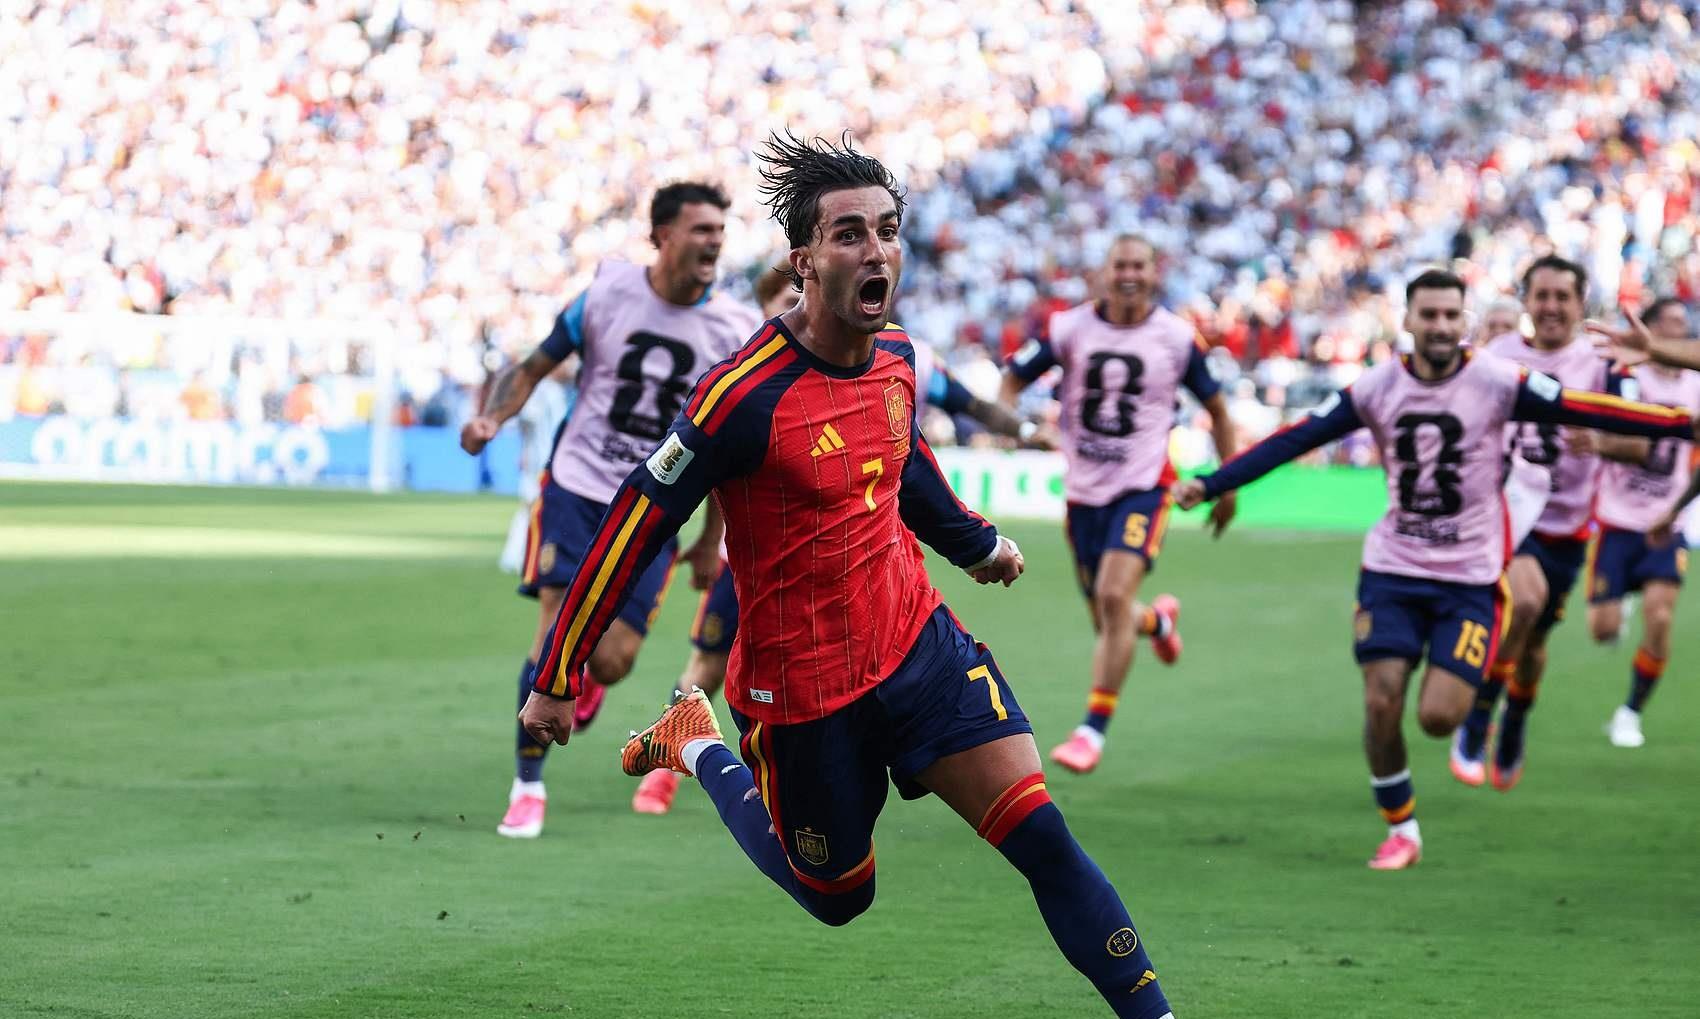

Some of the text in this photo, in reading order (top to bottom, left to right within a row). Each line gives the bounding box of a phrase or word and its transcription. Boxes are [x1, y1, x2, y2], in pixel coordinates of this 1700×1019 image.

[861, 457, 884, 512] 7
[1123, 512, 1148, 548] 5
[1453, 619, 1489, 669] 15
[966, 664, 1008, 721] 7
